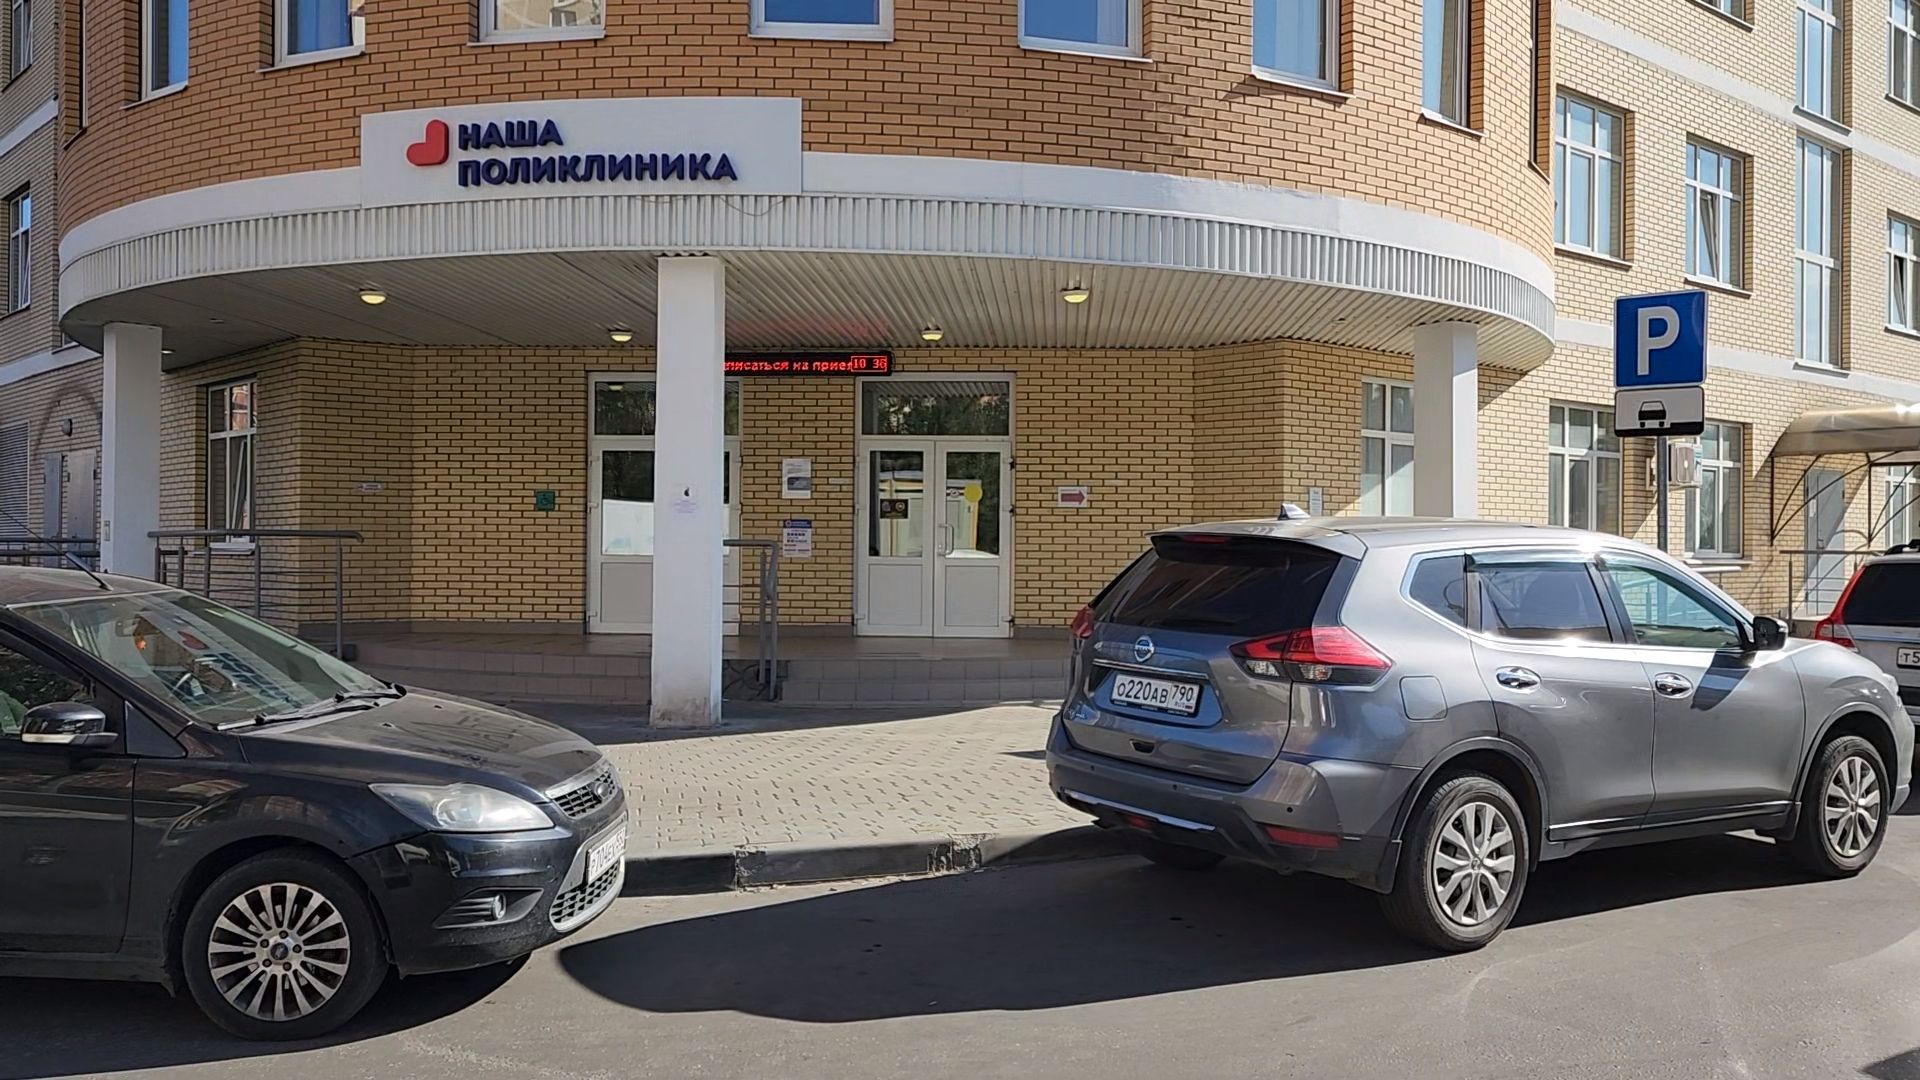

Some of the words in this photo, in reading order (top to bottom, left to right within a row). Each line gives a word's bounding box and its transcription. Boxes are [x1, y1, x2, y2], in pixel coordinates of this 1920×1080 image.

[458, 118, 563, 151] НАША
[458, 152, 738, 187] ПОЛИКЛИНИКА
[1637, 305, 1680, 376] P
[793, 361, 809, 371] на
[1172, 684, 1194, 702] 790
